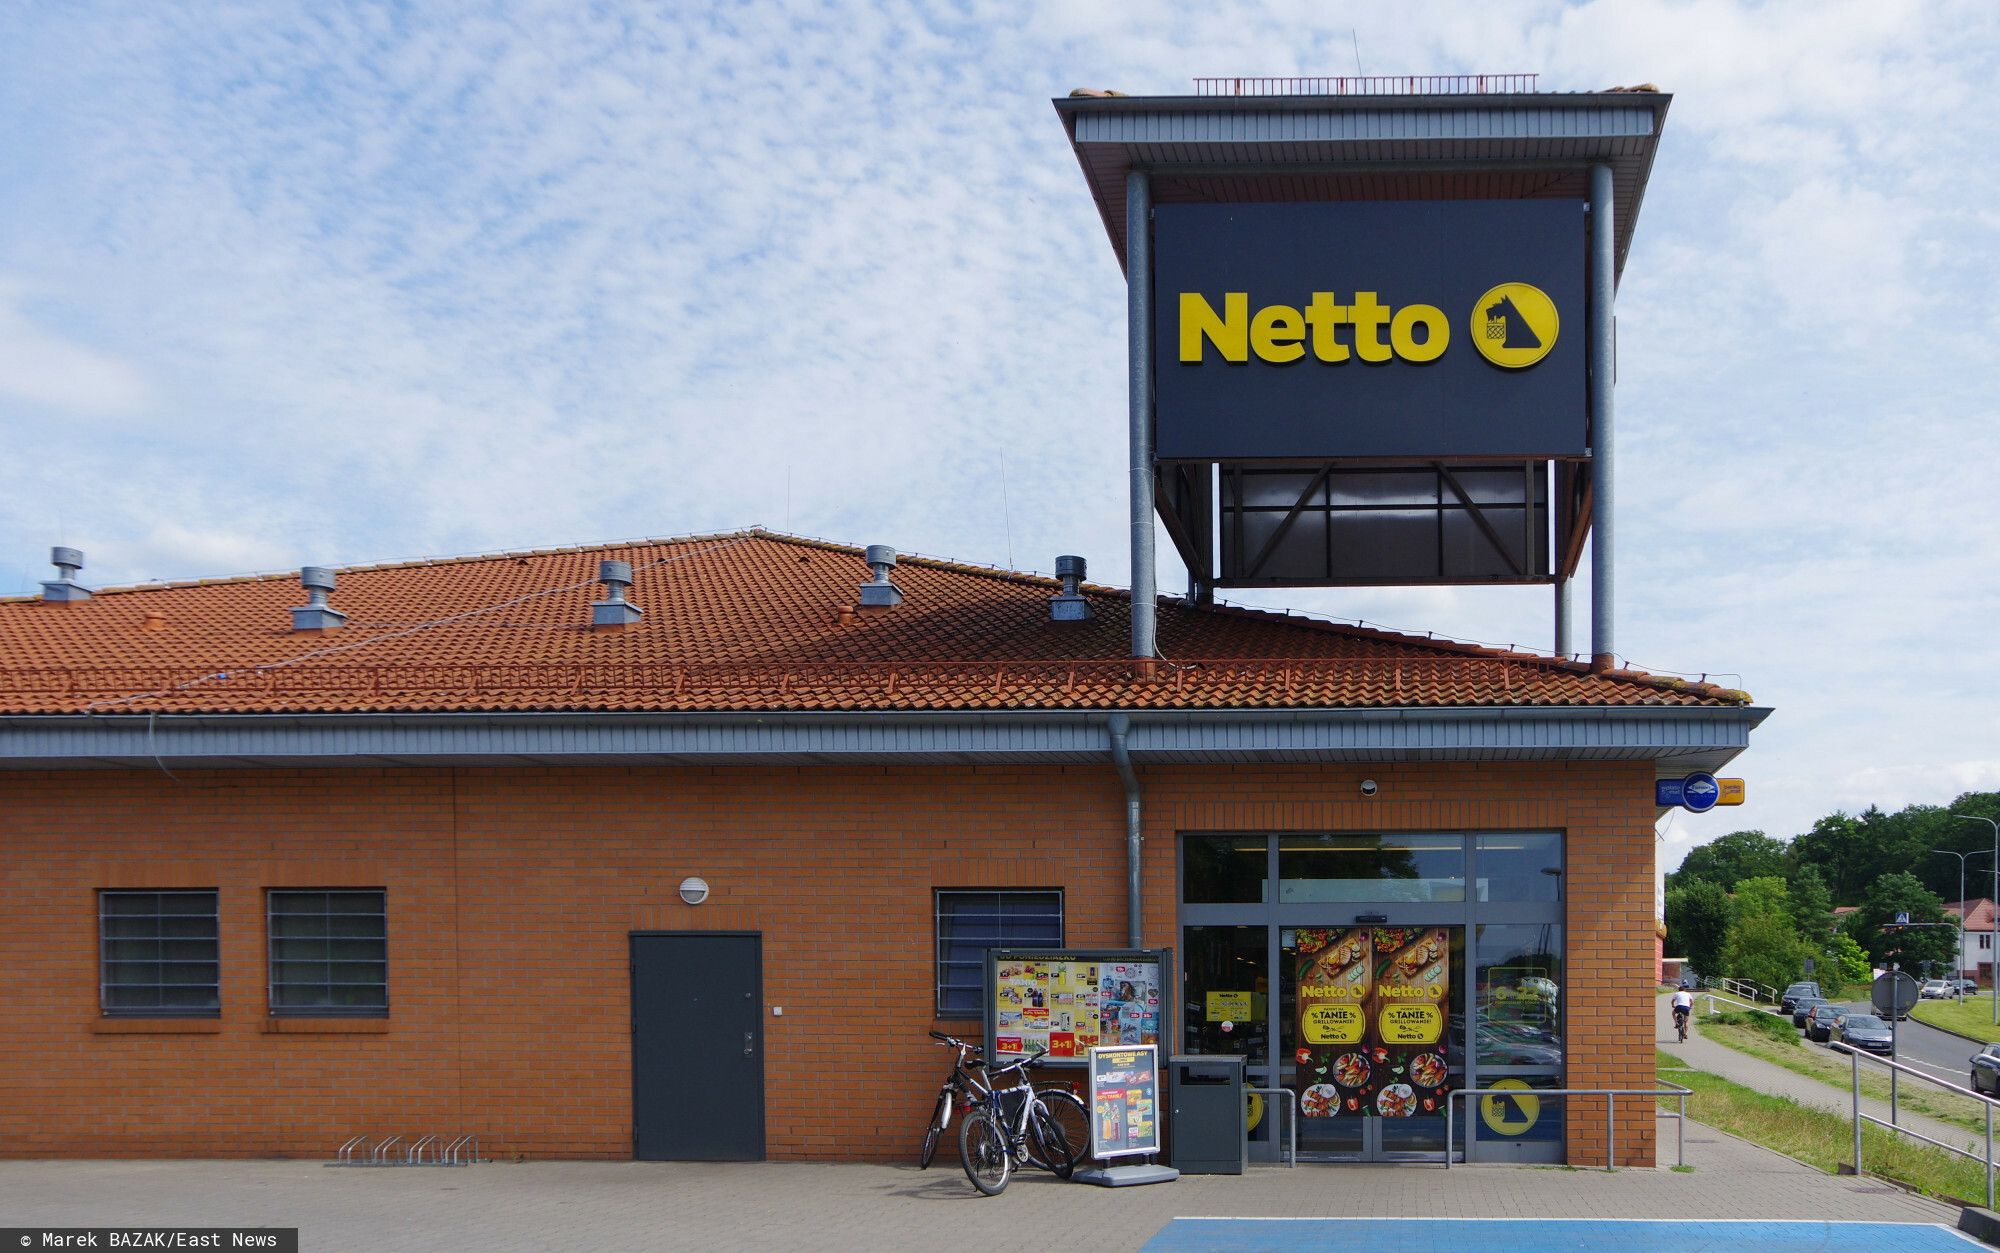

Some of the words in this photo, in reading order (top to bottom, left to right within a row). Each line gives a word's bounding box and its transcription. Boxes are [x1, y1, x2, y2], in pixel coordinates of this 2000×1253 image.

[1179, 291, 1450, 363] Netto
[1301, 985, 1347, 998] Netto
[1378, 984, 1425, 998] Netto
[1319, 1011, 1348, 1019] TANIE
[1396, 1011, 1425, 1019] TANIE
